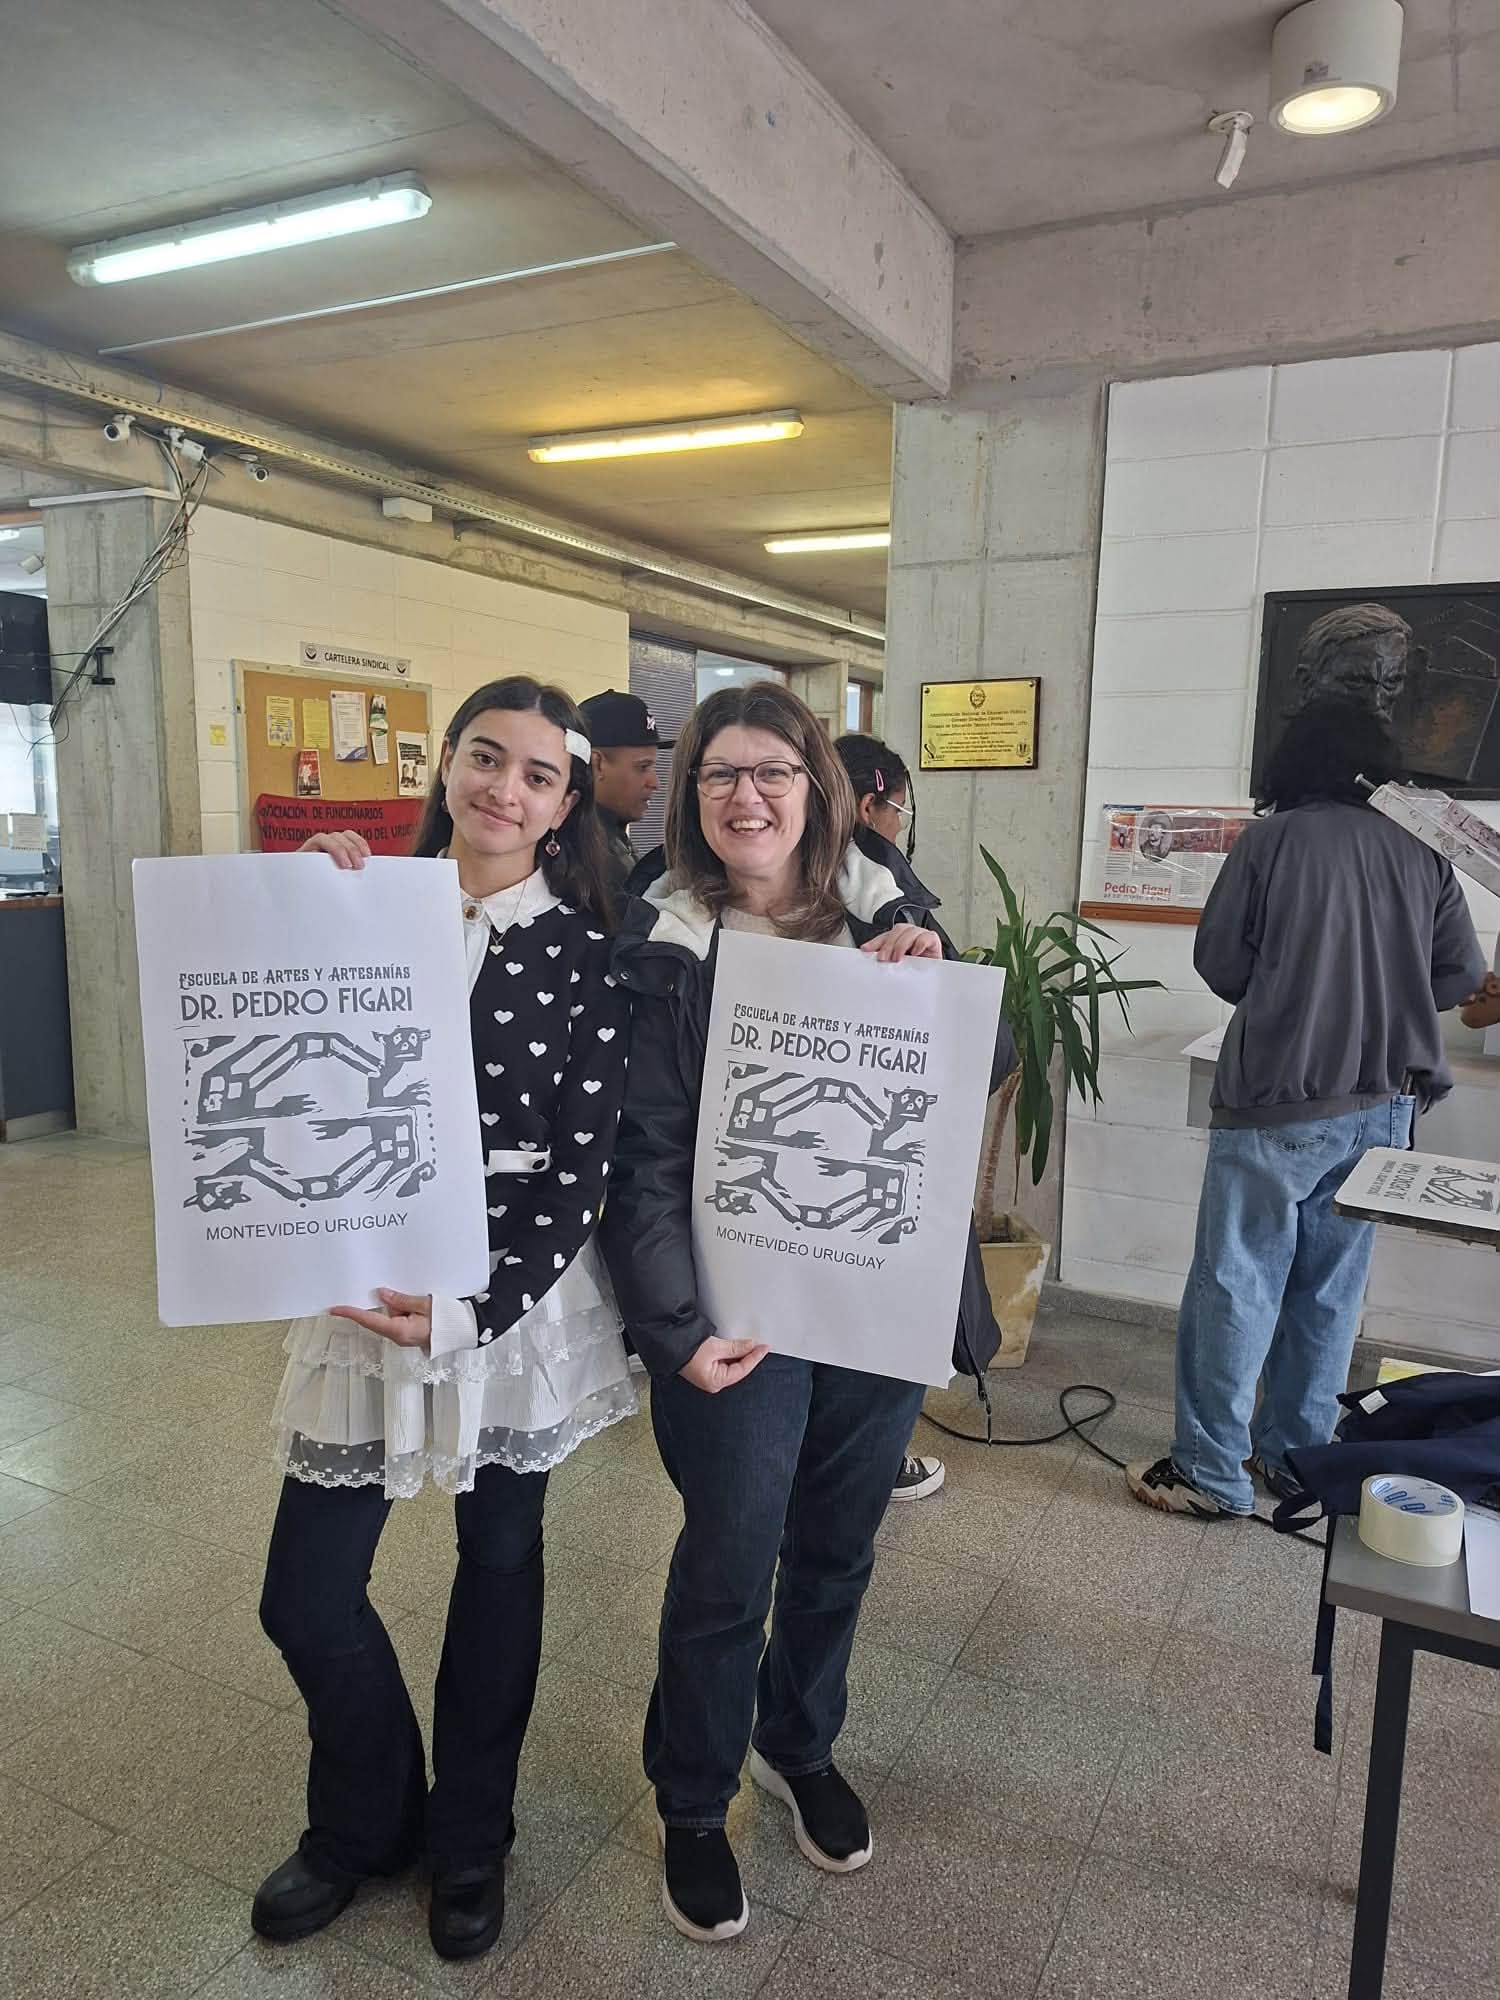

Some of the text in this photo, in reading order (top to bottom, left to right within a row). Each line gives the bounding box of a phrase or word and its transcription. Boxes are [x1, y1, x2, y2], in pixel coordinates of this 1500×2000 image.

[324, 652, 391, 671] CARTELERA SINDICAL
[313, 806, 323, 819] DE
[326, 807, 383, 820] FUNCIONARIOS
[374, 827, 388, 840] DEL
[1104, 882, 1137, 895] Pedro
[242, 970, 258, 985] DE
[314, 968, 323, 982] Y
[180, 986, 413, 1021] DR. PEDRO FIGARI
[782, 1013, 797, 1026] DE
[844, 1022, 852, 1034] Y
[730, 1022, 928, 1076] DR. PEDRO FIGARI
[206, 1212, 409, 1241] MONTEVIDEO URUGUAY
[716, 1225, 886, 1271] MONTEVIDEO URUGUAY
